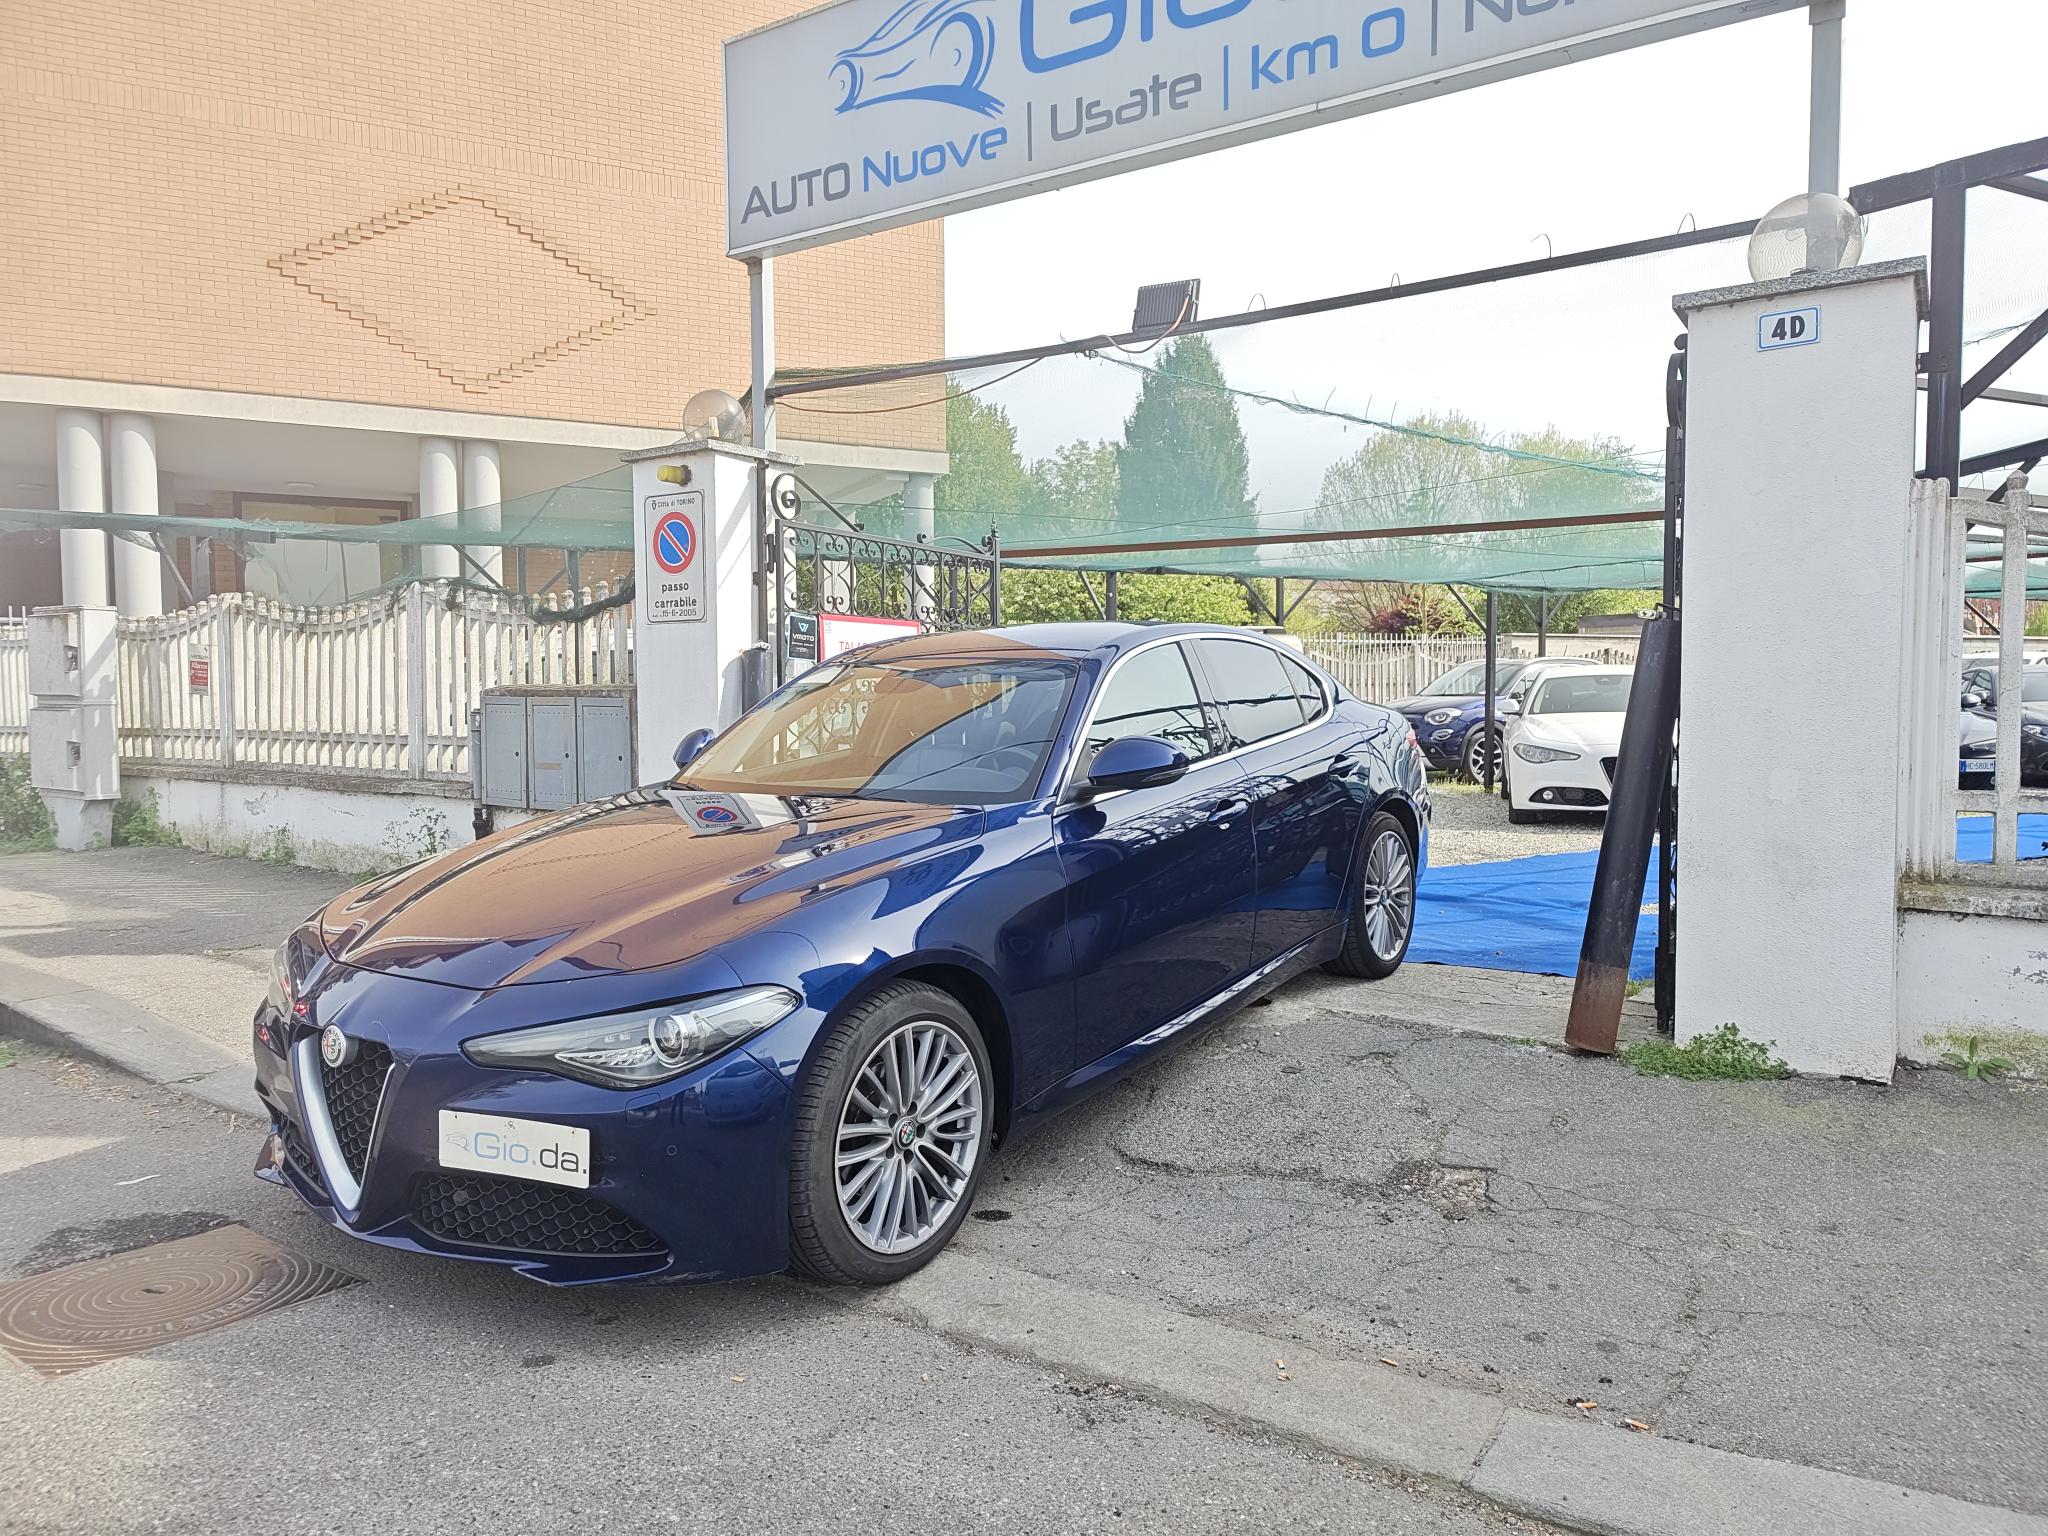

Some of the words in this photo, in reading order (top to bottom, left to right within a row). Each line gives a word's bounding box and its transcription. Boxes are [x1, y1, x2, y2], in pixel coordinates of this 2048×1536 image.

[741, 162, 850, 225] AUTO
[863, 127, 1008, 192] Nuove
[1050, 72, 1202, 141] Usate
[1771, 315, 1806, 341] 4D
[661, 582, 689, 594] passo
[654, 596, 697, 609] carrabile
